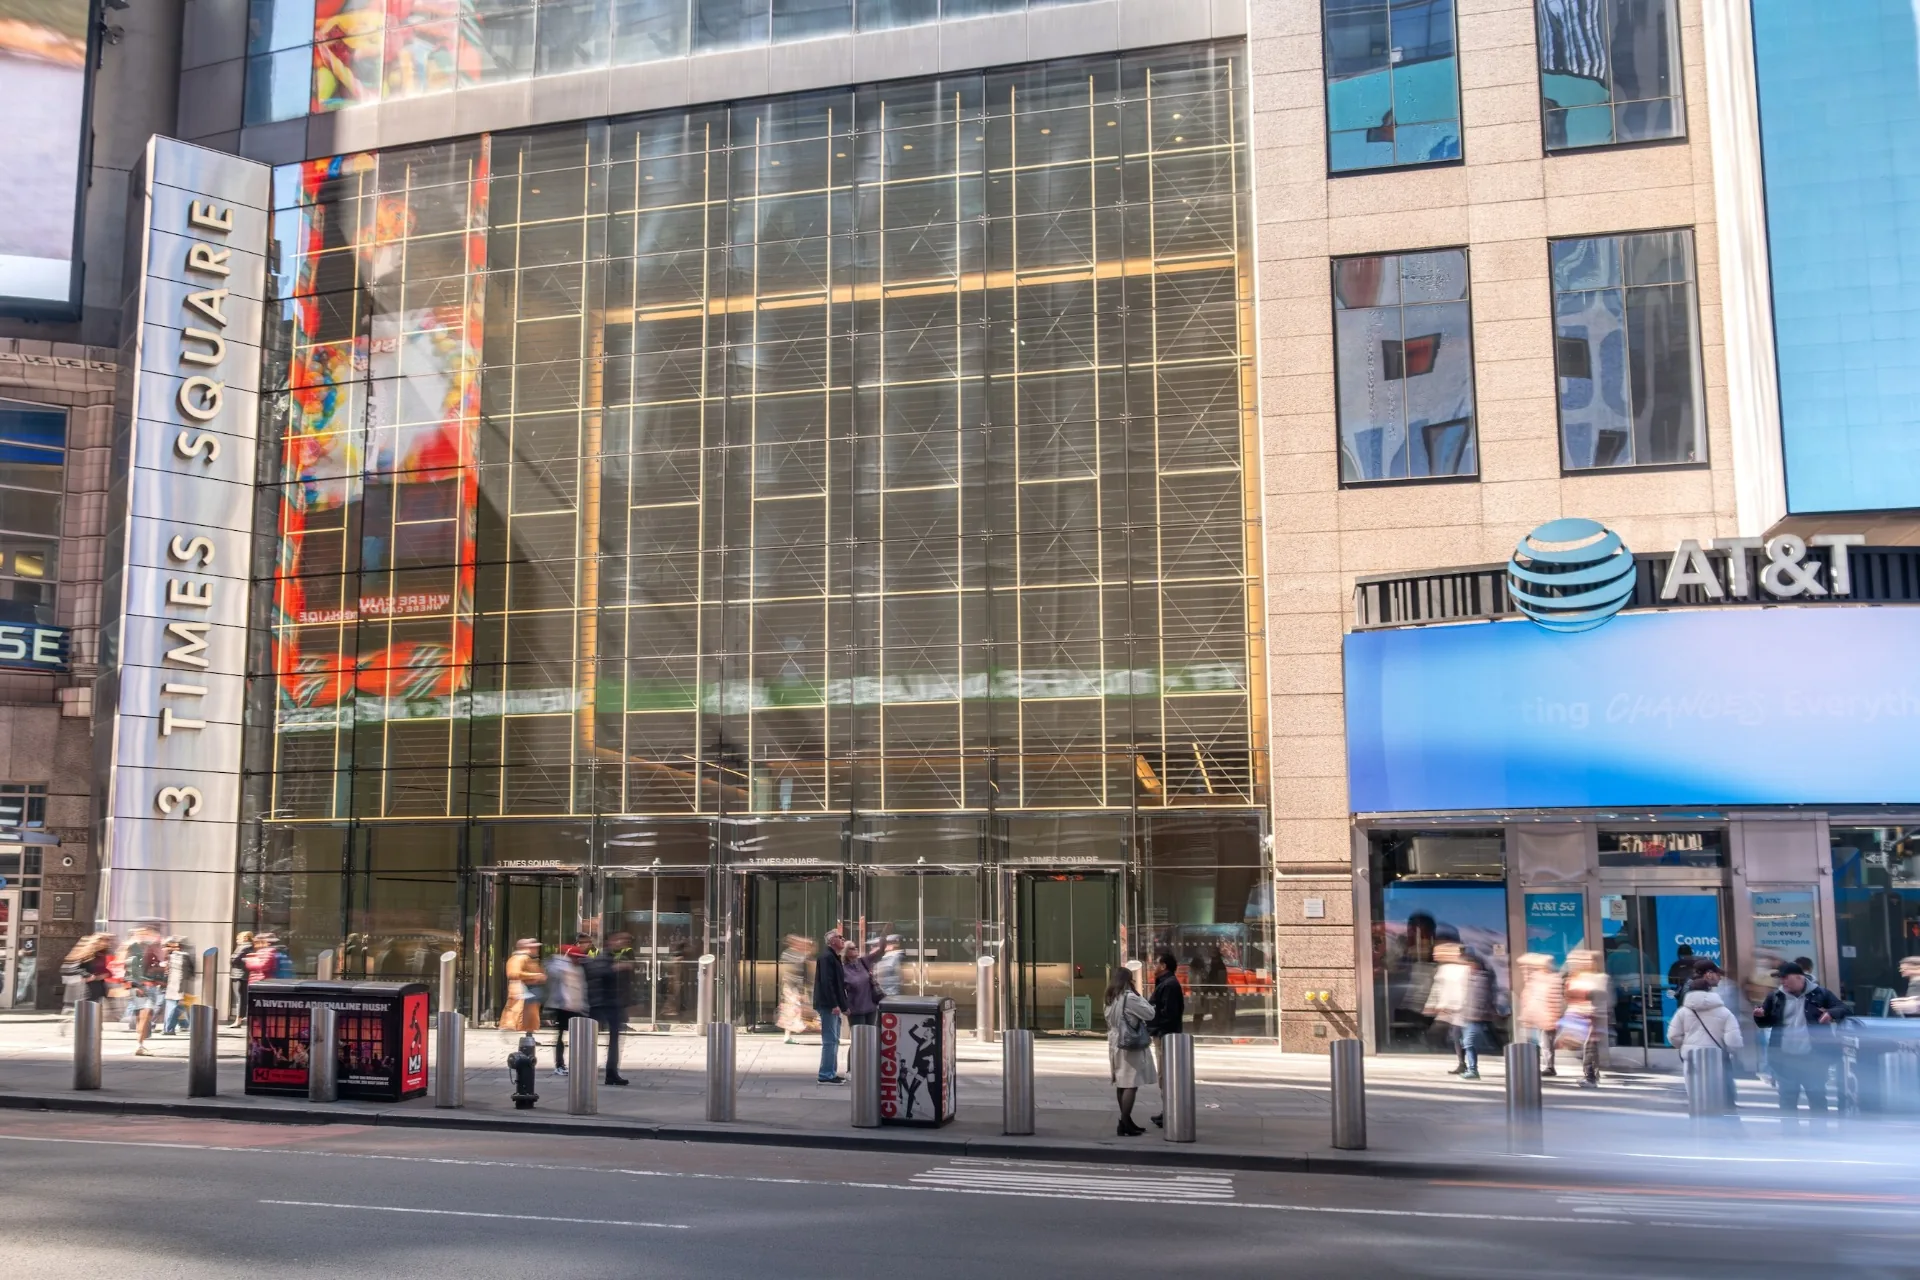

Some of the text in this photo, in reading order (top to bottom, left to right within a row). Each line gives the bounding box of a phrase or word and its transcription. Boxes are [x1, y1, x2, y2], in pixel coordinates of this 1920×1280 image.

[156, 199, 235, 818] 3 TIMES SQUARE
[1660, 533, 1866, 601] AT&T
[0, 626, 63, 663] SE
[496, 860, 561, 868] 3 TIMES SQUARE
[1030, 856, 1058, 864] TIMES
[1061, 856, 1099, 864] SQUARE
[1531, 902, 1577, 911] AT&T 5G
[1674, 934, 1720, 946] Conne
[1779, 930, 1803, 938] every
[263, 999, 304, 1008] RIVETING
[305, 1001, 361, 1011] ADRENALINE
[408, 1054, 422, 1072] MJ
[881, 1012, 897, 1118] CHICAGO
